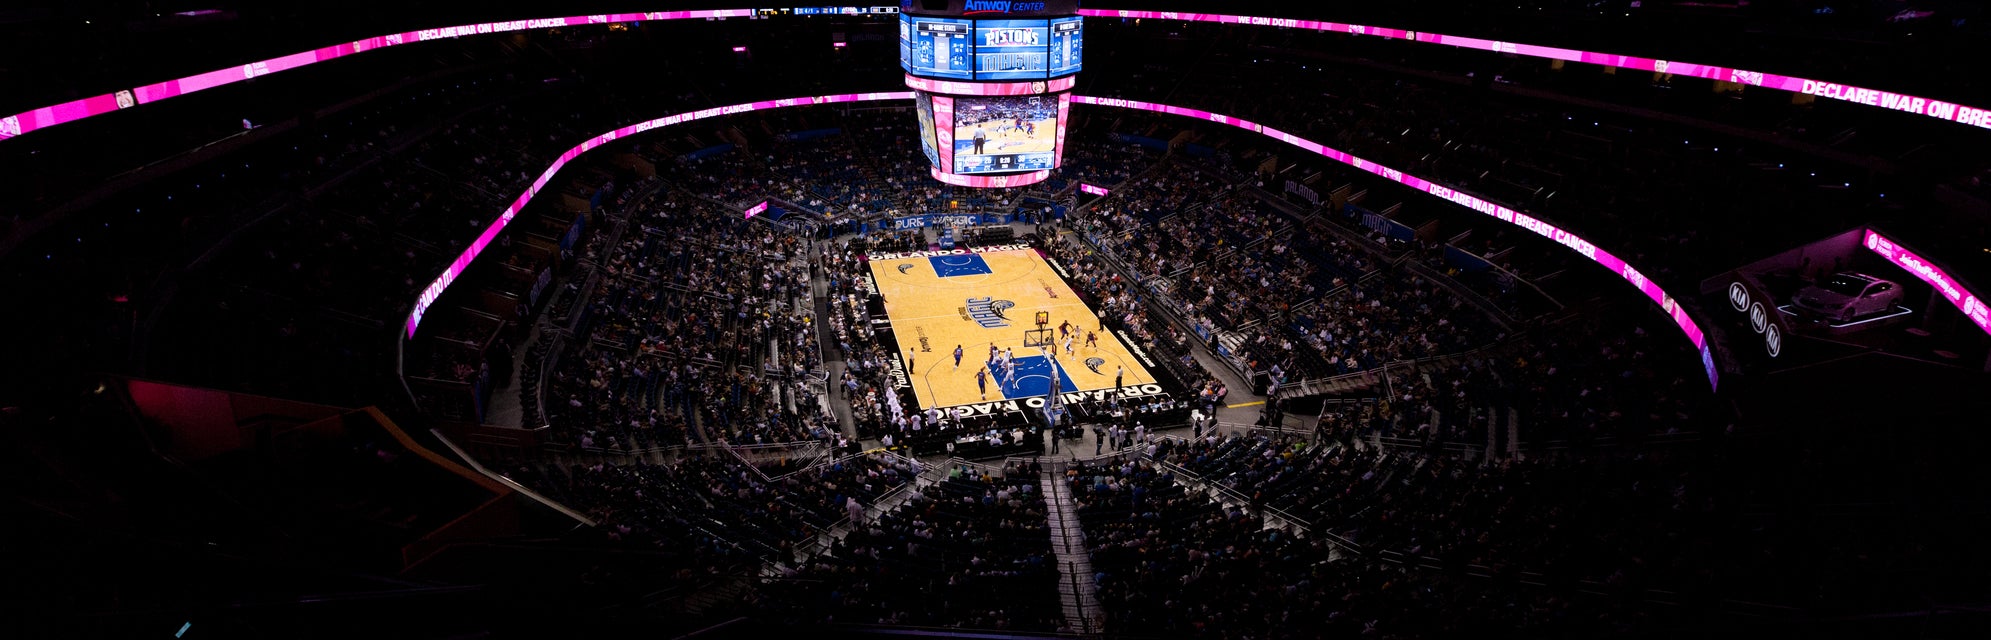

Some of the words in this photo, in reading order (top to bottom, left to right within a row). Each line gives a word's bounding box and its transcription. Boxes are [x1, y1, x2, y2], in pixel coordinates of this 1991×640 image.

[964, 0, 1011, 13] Amway
[1013, 2, 1045, 11] CENTER
[417, 28, 456, 41] DECLARE
[456, 24, 476, 37] WAR
[477, 23, 491, 34] ON
[492, 20, 526, 33] BREAST
[527, 17, 567, 30] CANCER.
[1238, 15, 1251, 24] WE
[1252, 16, 1270, 26] CAN
[1272, 18, 1284, 27] DO
[1285, 18, 1296, 28] IT!
[985, 29, 1039, 46] PISTONS
[1085, 96, 1097, 105] WE
[1098, 97, 1114, 107] CAN
[1115, 98, 1126, 108] DO
[1801, 79, 1879, 106] DECLARE
[1879, 92, 1923, 115] WAR
[1926, 100, 1956, 120] ON
[1956, 105, 1991, 129] BRE
[636, 118, 666, 132] DECLARE
[666, 115, 681, 127] WAR
[682, 112, 693, 123] ON
[694, 108, 722, 121] BREAST
[723, 103, 755, 116] CANCER.
[895, 217, 925, 230] PURE
[1429, 182, 1472, 208] DECLARE
[1472, 197, 1496, 217] WAR
[1497, 206, 1513, 223] ON
[1514, 212, 1555, 240] BREAST
[1555, 229, 1597, 261] CANCER.
[868, 249, 966, 261] ORLANDO
[970, 243, 1031, 254] MAGIC
[413, 303, 422, 328] WE
[419, 288, 434, 314] CAN
[432, 277, 444, 300] DO
[442, 267, 453, 289] IT!
[1732, 285, 1746, 309] KIA
[966, 296, 1012, 328] MAGIC
[1752, 305, 1764, 330] KIA
[1767, 327, 1778, 353] KIA
